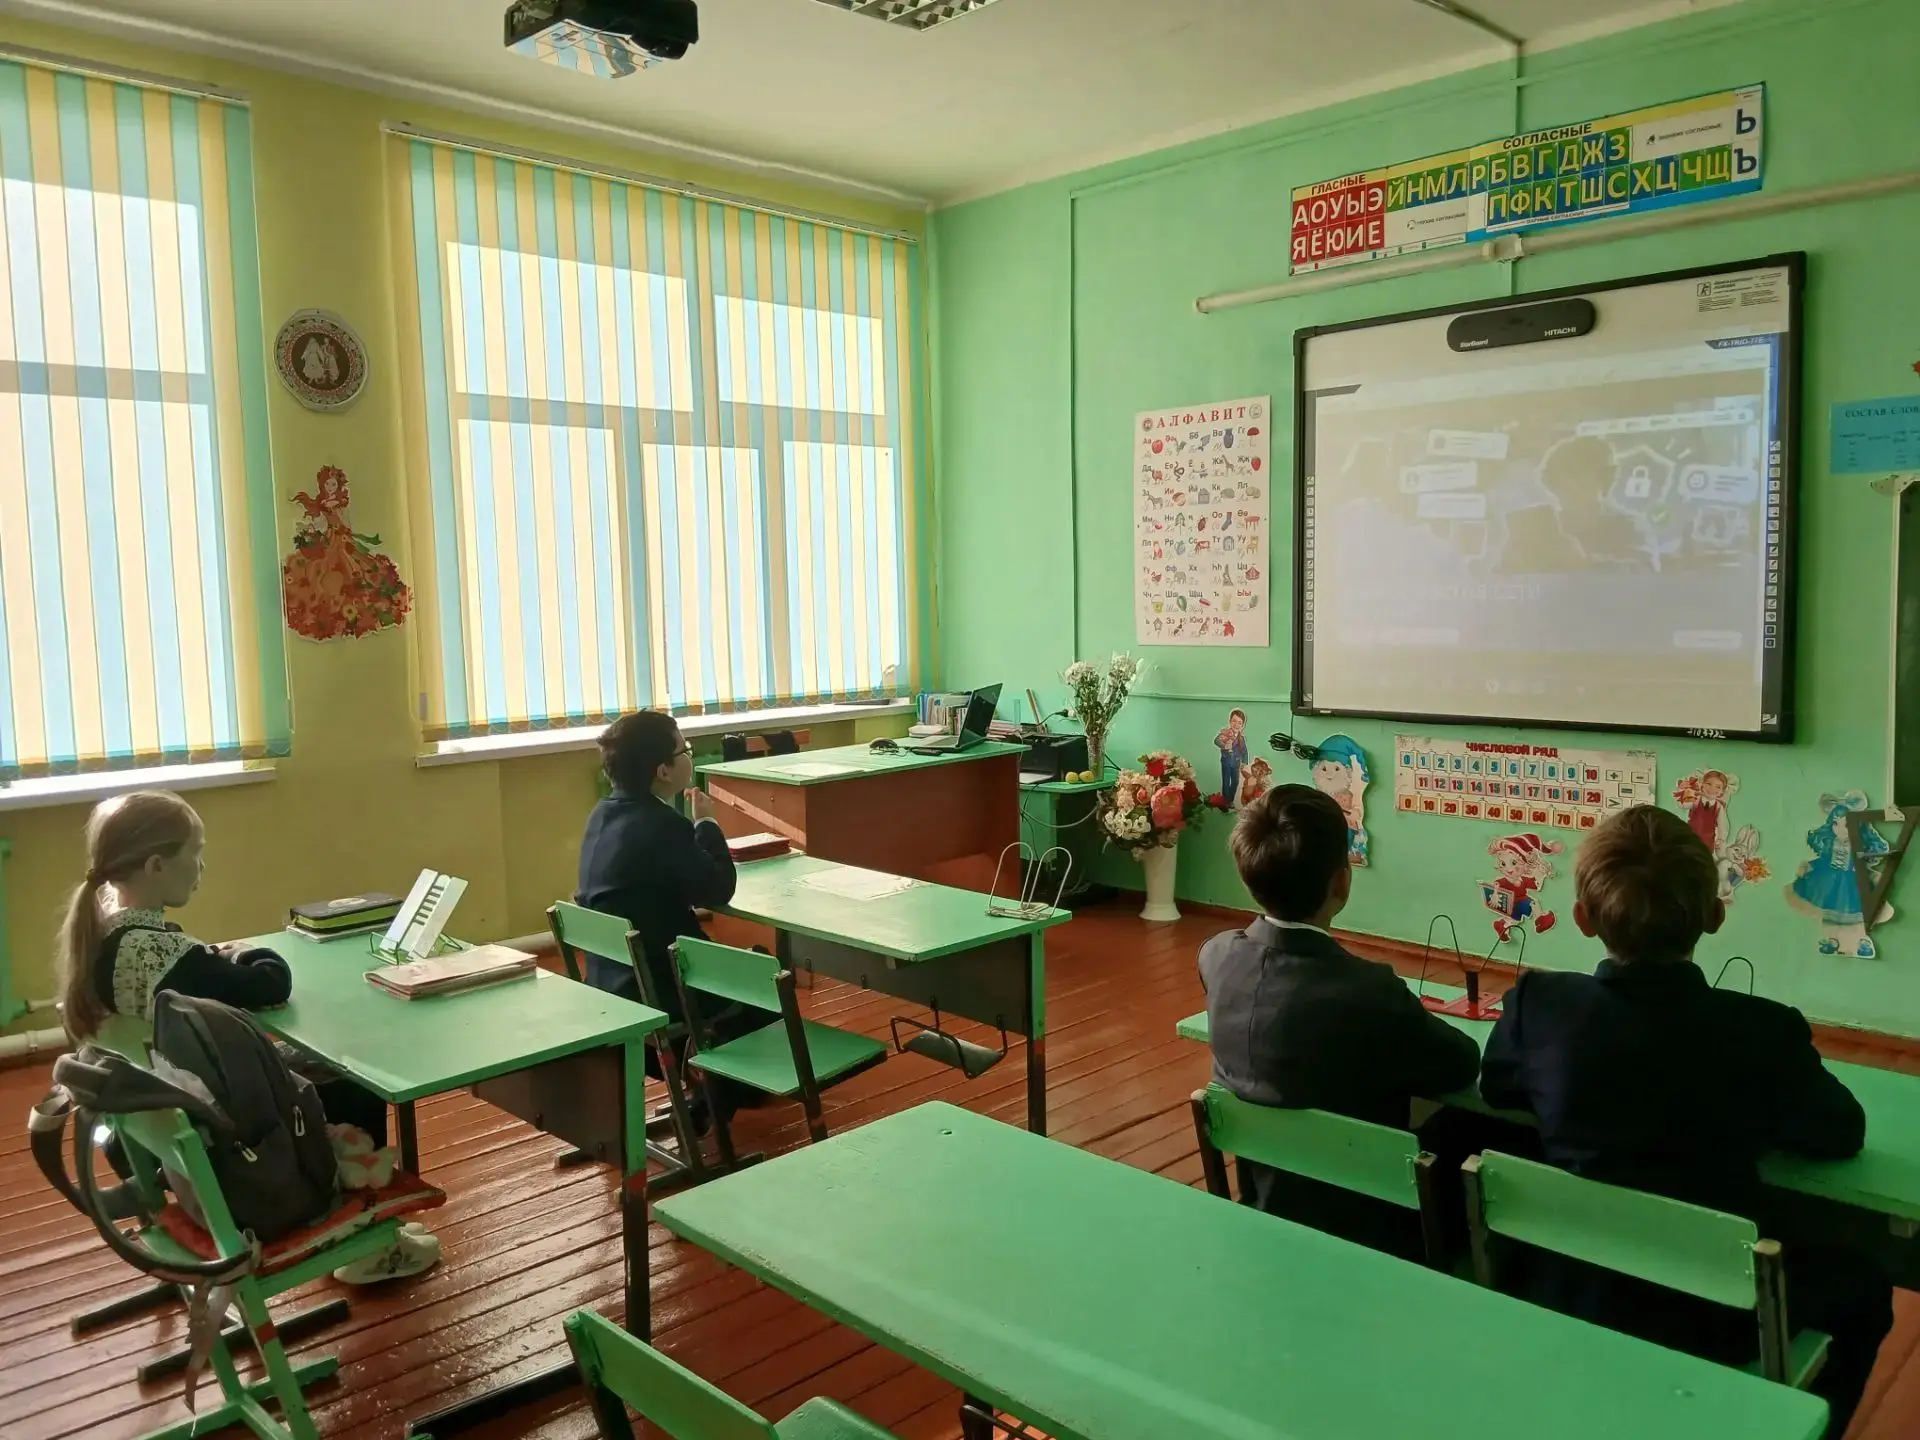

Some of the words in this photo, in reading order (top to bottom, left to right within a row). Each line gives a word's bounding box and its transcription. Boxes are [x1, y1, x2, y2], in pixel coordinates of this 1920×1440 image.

[1503, 123, 1593, 150] СОГЛАСНЫЕ
[1311, 174, 1366, 195] ГЛАСНЫЕ
[1544, 326, 1577, 337] HITACHI
[1156, 406, 1247, 429] АЛФАВИТ
[1466, 742, 1530, 755] ЧИСЛОВОЙ
[1533, 746, 1559, 758] РЯД
[1403, 754, 1411, 764] 0
[1420, 756, 1426, 766] 1
[1437, 758, 1445, 768] 2
[1454, 759, 1462, 769] 3
[1472, 760, 1480, 771] 4
[1490, 761, 1498, 772] 5
[1509, 763, 1517, 774] 6
[1529, 764, 1537, 775] 7
[1567, 767, 1576, 779] 9
[1585, 769, 1597, 780] 10
[1419, 777, 1428, 787] 11
[1434, 778, 1446, 789] 12
[1452, 779, 1464, 790] 13
[1470, 781, 1481, 792] 14
[1489, 782, 1501, 793] 15
[1508, 784, 1520, 795] 16
[1527, 786, 1540, 797] 17
[1567, 788, 1579, 801] 19
[1586, 791, 1601, 803] 20
[1404, 798, 1411, 808] 0
[1424, 800, 1434, 811] 10
[1444, 802, 1456, 813] 20
[1465, 804, 1478, 816] 30
[1487, 806, 1501, 818] 40
[1510, 808, 1523, 820] 50
[1532, 811, 1546, 823] 60
[1557, 813, 1571, 825] 70
